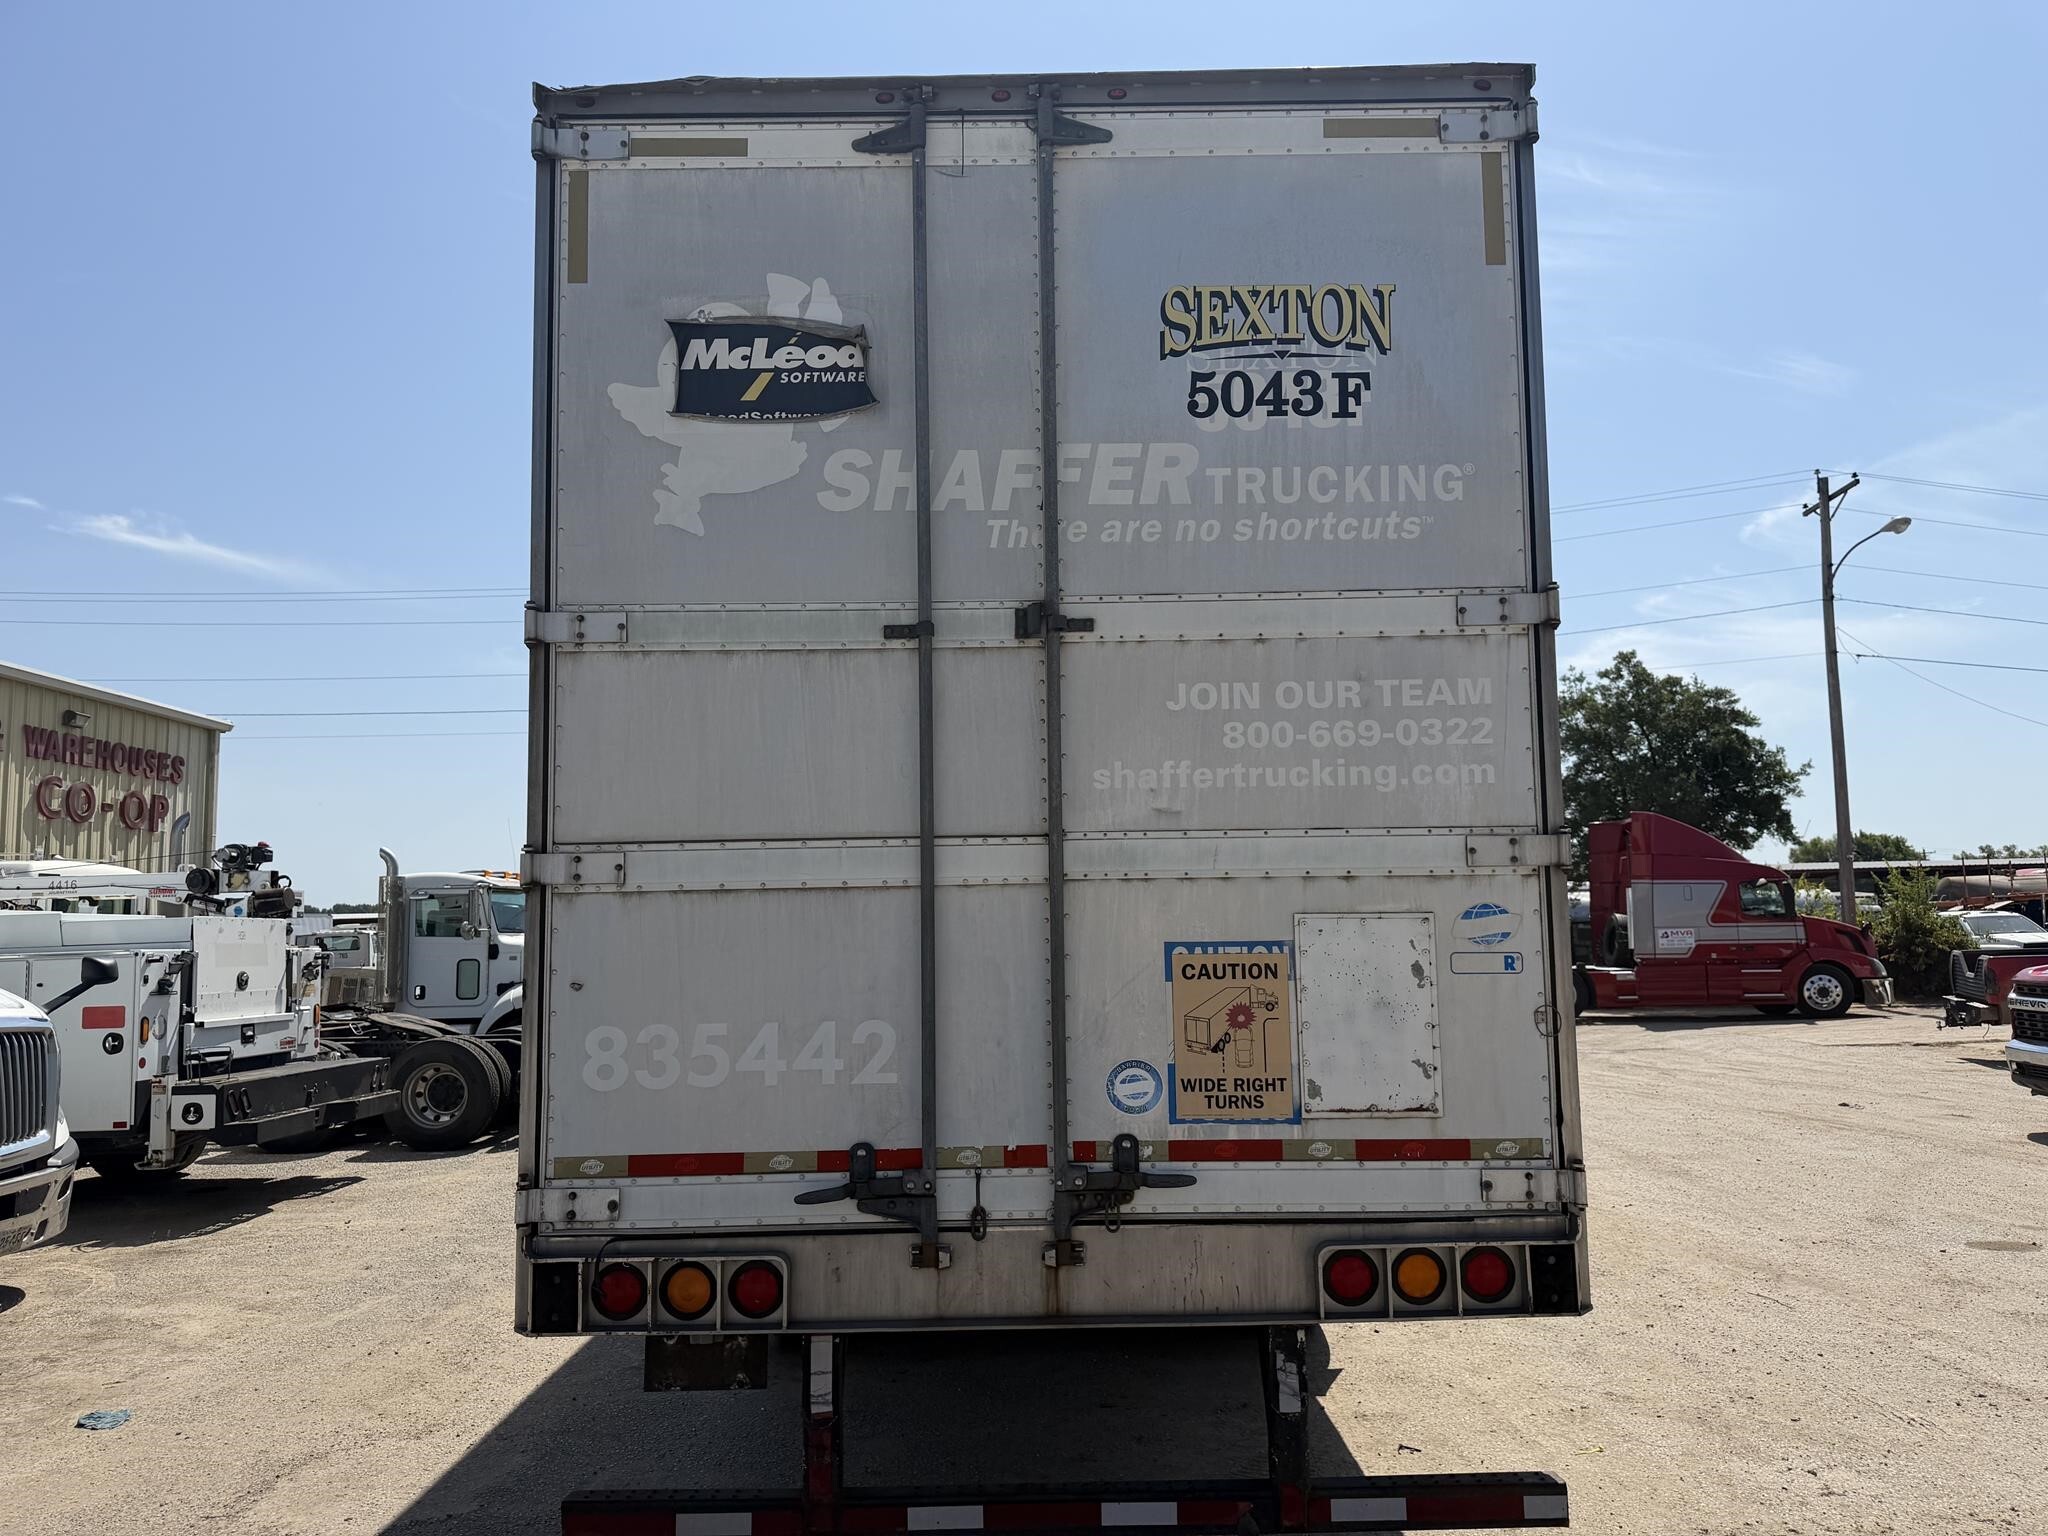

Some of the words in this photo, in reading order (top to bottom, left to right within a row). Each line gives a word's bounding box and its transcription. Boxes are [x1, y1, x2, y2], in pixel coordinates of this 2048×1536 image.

[1160, 283, 1396, 361] SEXTON
[780, 371, 865, 384] SOFTWARE
[816, 443, 1199, 512] SHAFFER
[986, 519, 1088, 549] The
[1101, 518, 1162, 543] are
[1175, 519, 1221, 543] no
[1166, 682, 1260, 711] JOIN
[1275, 680, 1362, 710] OUR
[1374, 678, 1493, 708] TEAM
[1222, 717, 1494, 748] 800-669-0322
[24, 724, 185, 785] WAREHOUSES
[1093, 758, 1496, 792] shaffertrucking.com
[37, 775, 169, 832] CO-OP
[48, 879, 78, 890] 4416
[1181, 963, 1279, 980] CAUTION
[2009, 999, 2048, 1009] CHEVR
[582, 1019, 898, 1091] 835442
[1180, 1078, 1227, 1092] WIDE
[1233, 1078, 1287, 1092] RIGHT
[1204, 1095, 1264, 1109] TURNS
